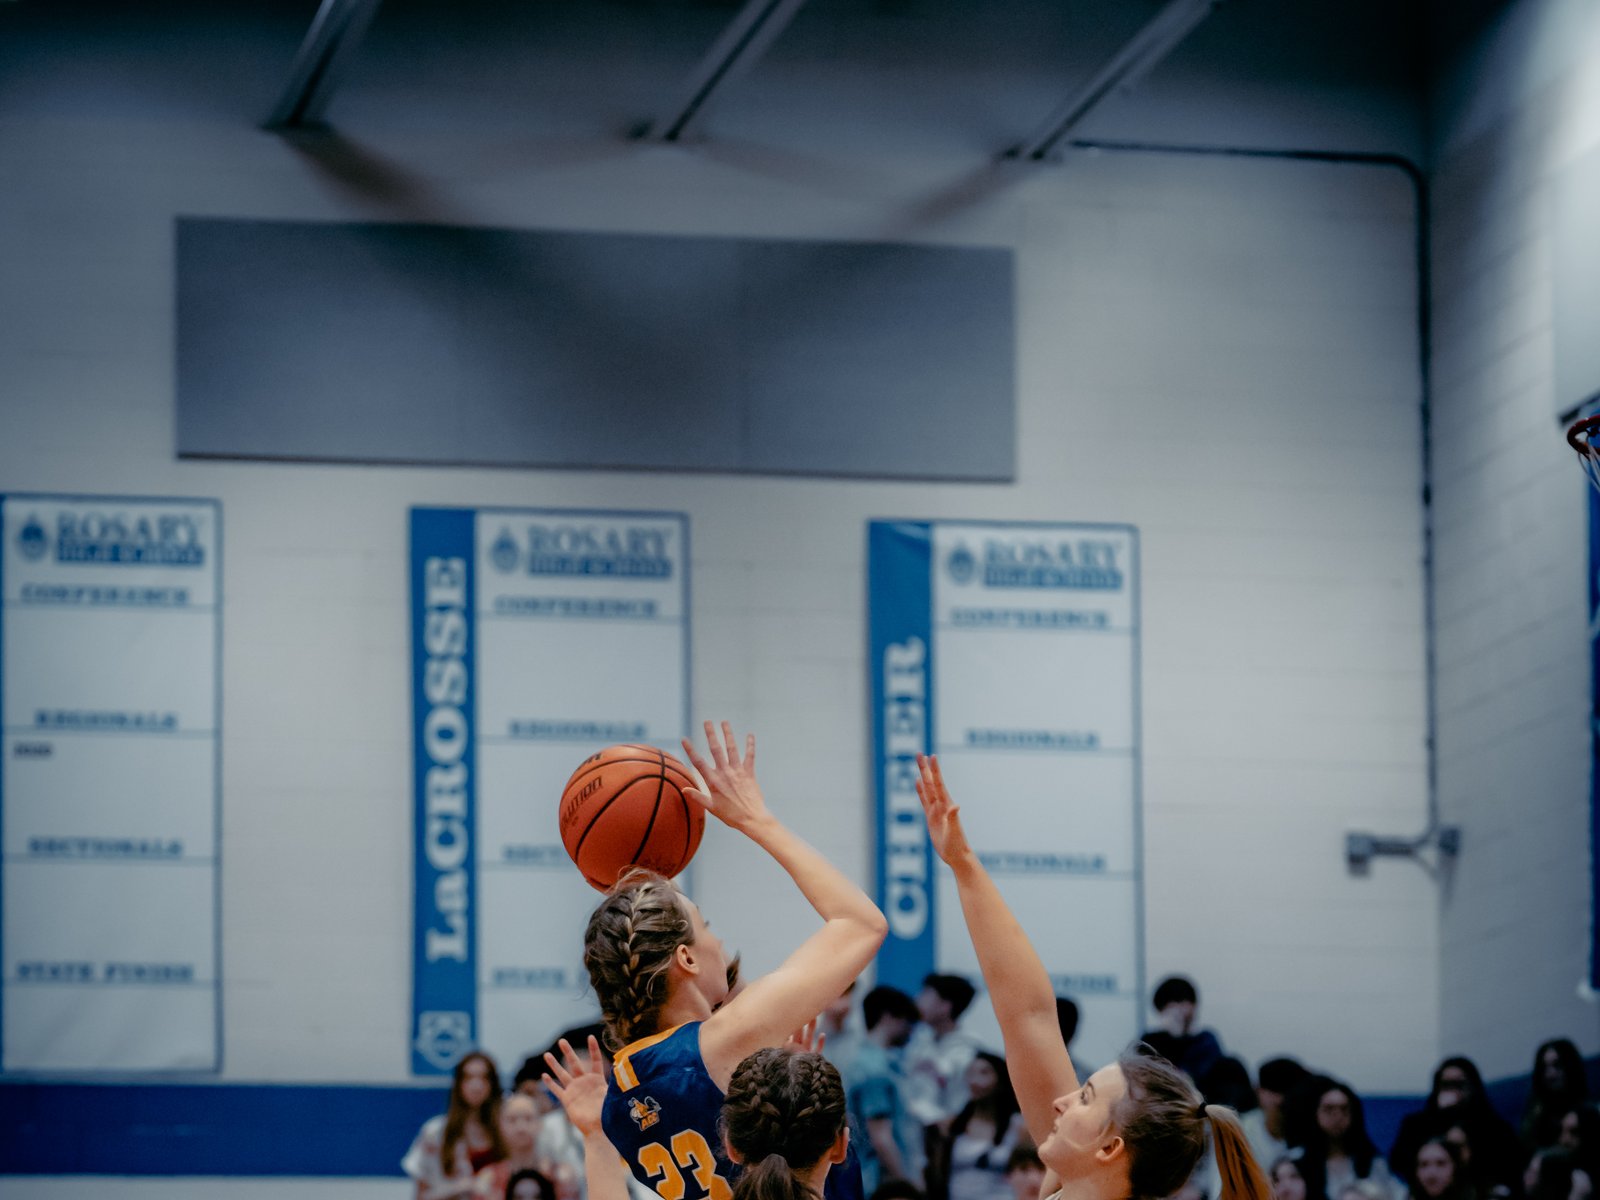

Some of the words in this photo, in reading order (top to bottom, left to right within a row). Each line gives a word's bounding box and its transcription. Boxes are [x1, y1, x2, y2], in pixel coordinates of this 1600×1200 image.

[57, 514, 202, 544] ROSARY
[528, 524, 673, 555] ROSARY
[984, 540, 1121, 567] ROSARY
[424, 557, 468, 962] LaCROSSE
[883, 634, 927, 940] CHEER
